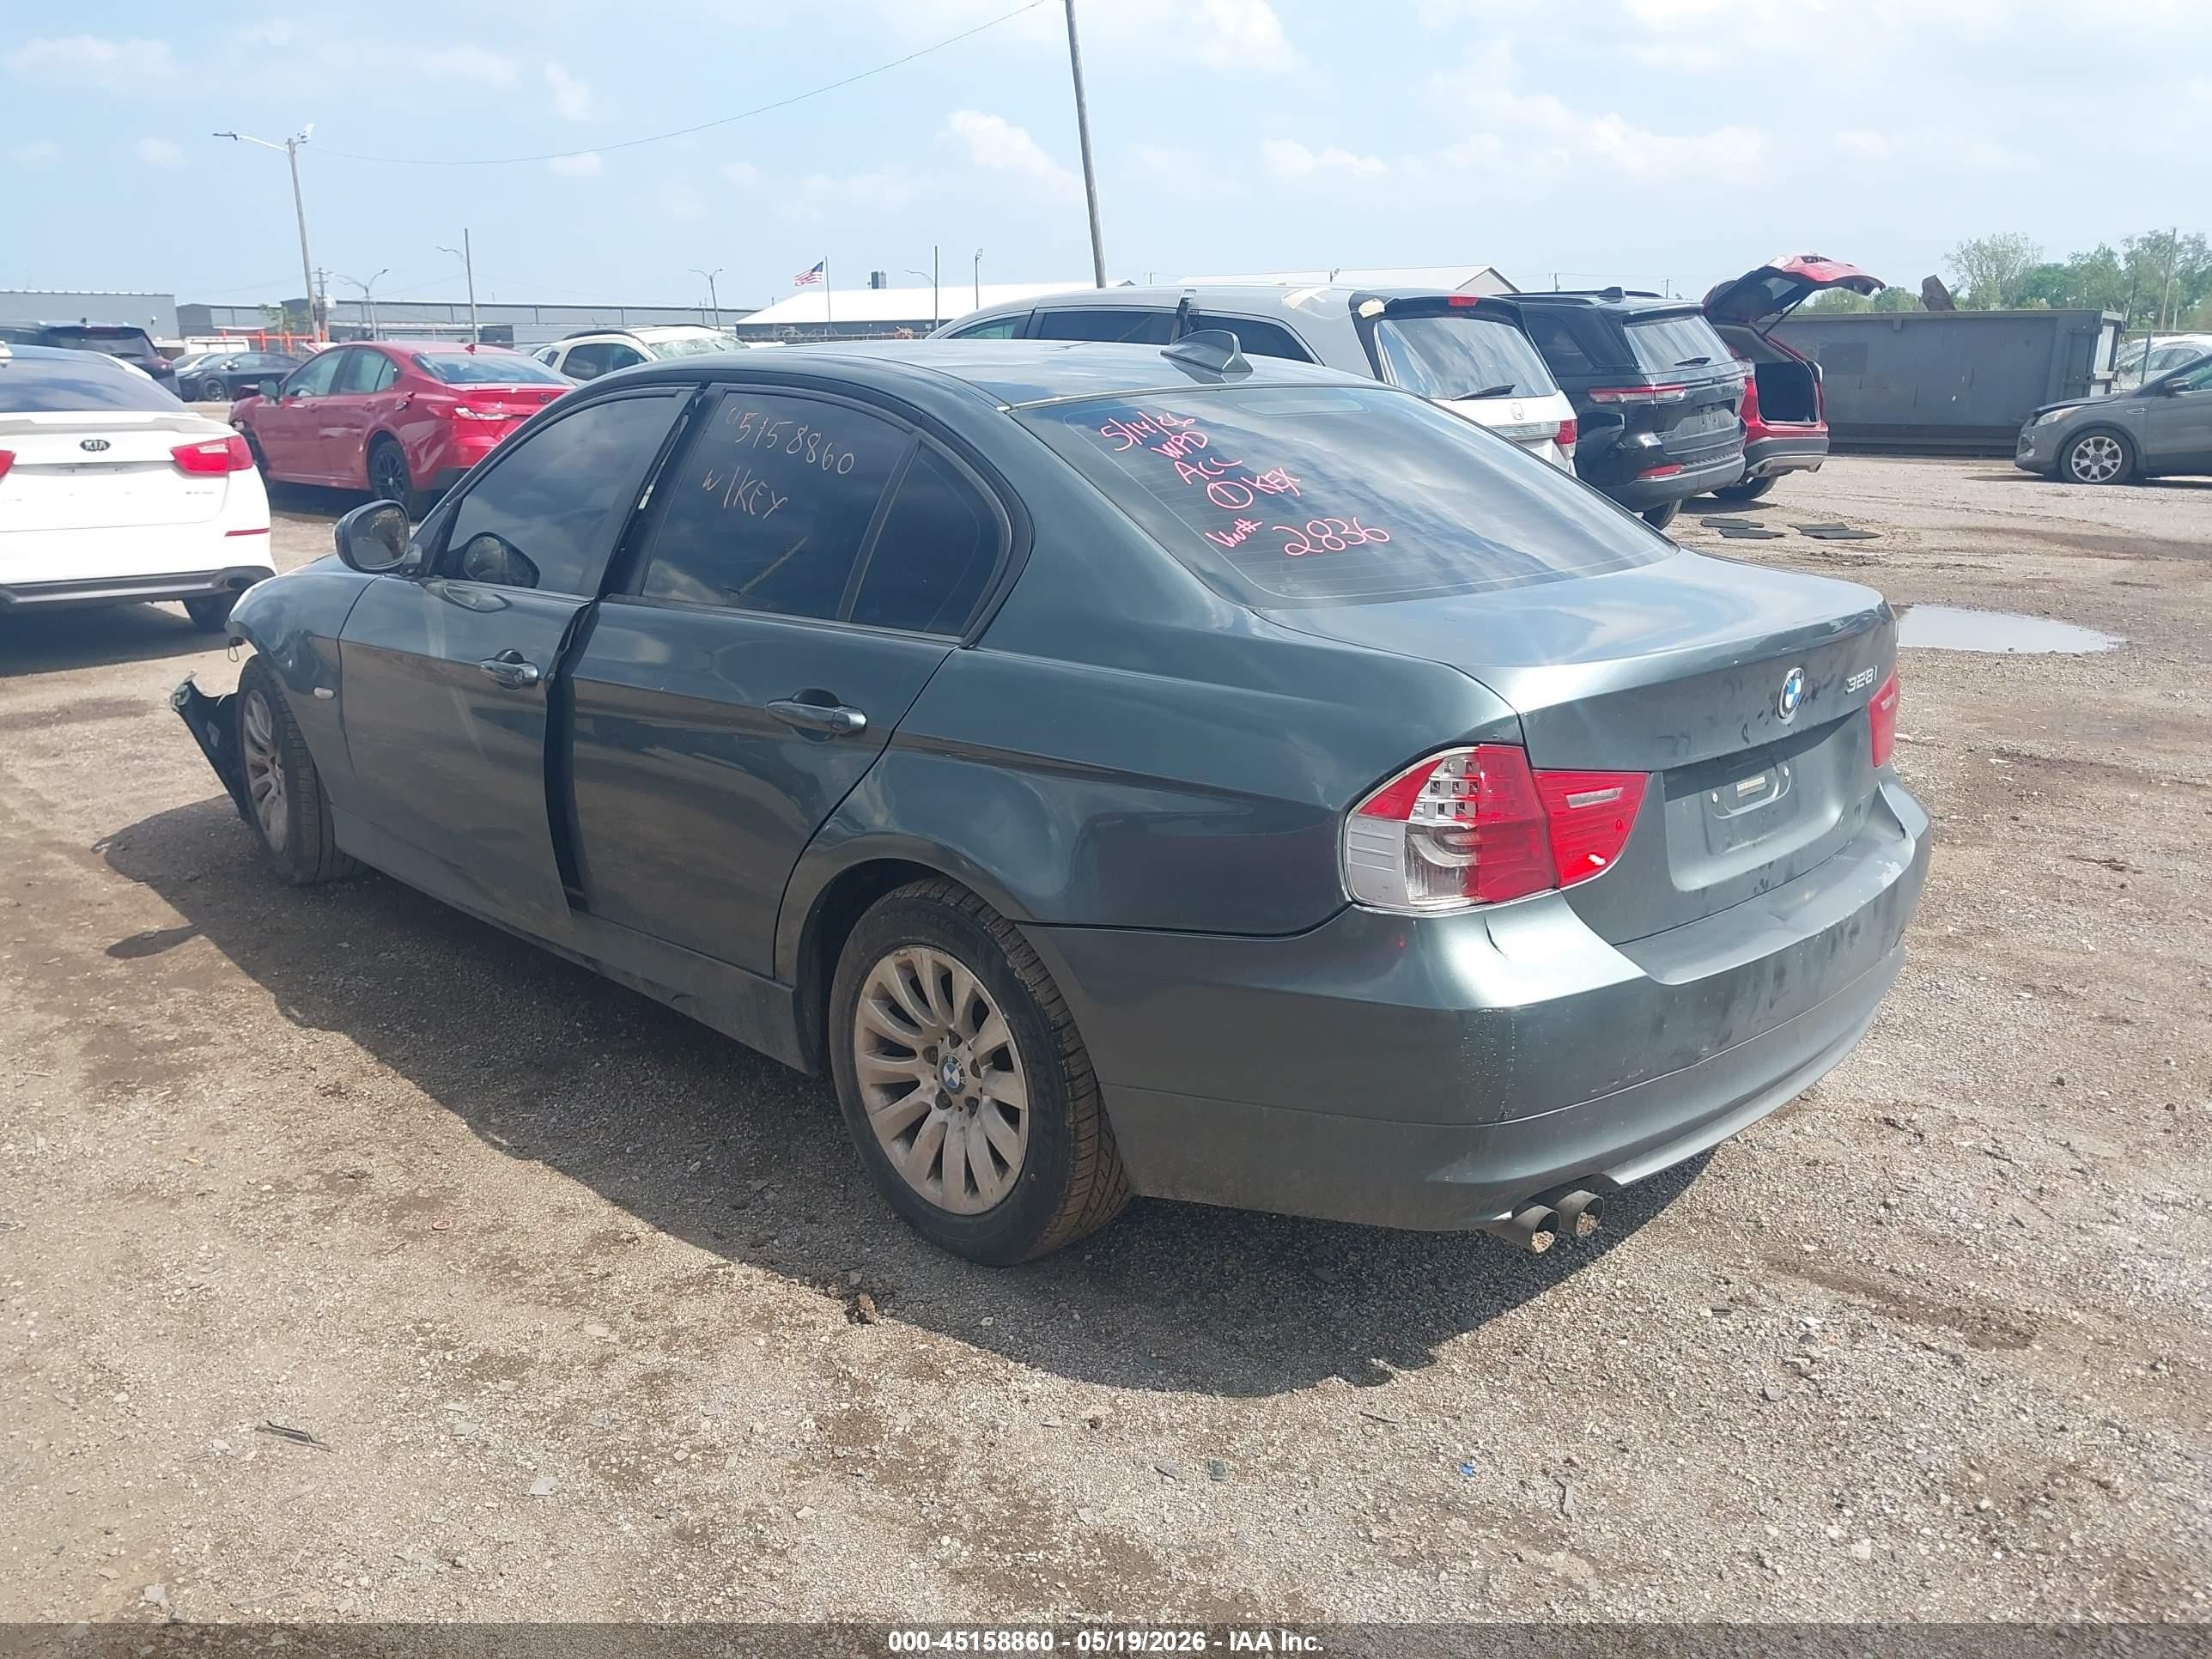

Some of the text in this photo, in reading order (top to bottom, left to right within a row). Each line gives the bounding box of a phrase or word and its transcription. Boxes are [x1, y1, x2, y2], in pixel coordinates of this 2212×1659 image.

[82, 440, 109, 452] KIA
[1240, 467, 1303, 497] KEY
[1272, 516, 1391, 557] 2836
[945, 1056, 966, 1086] BMW
